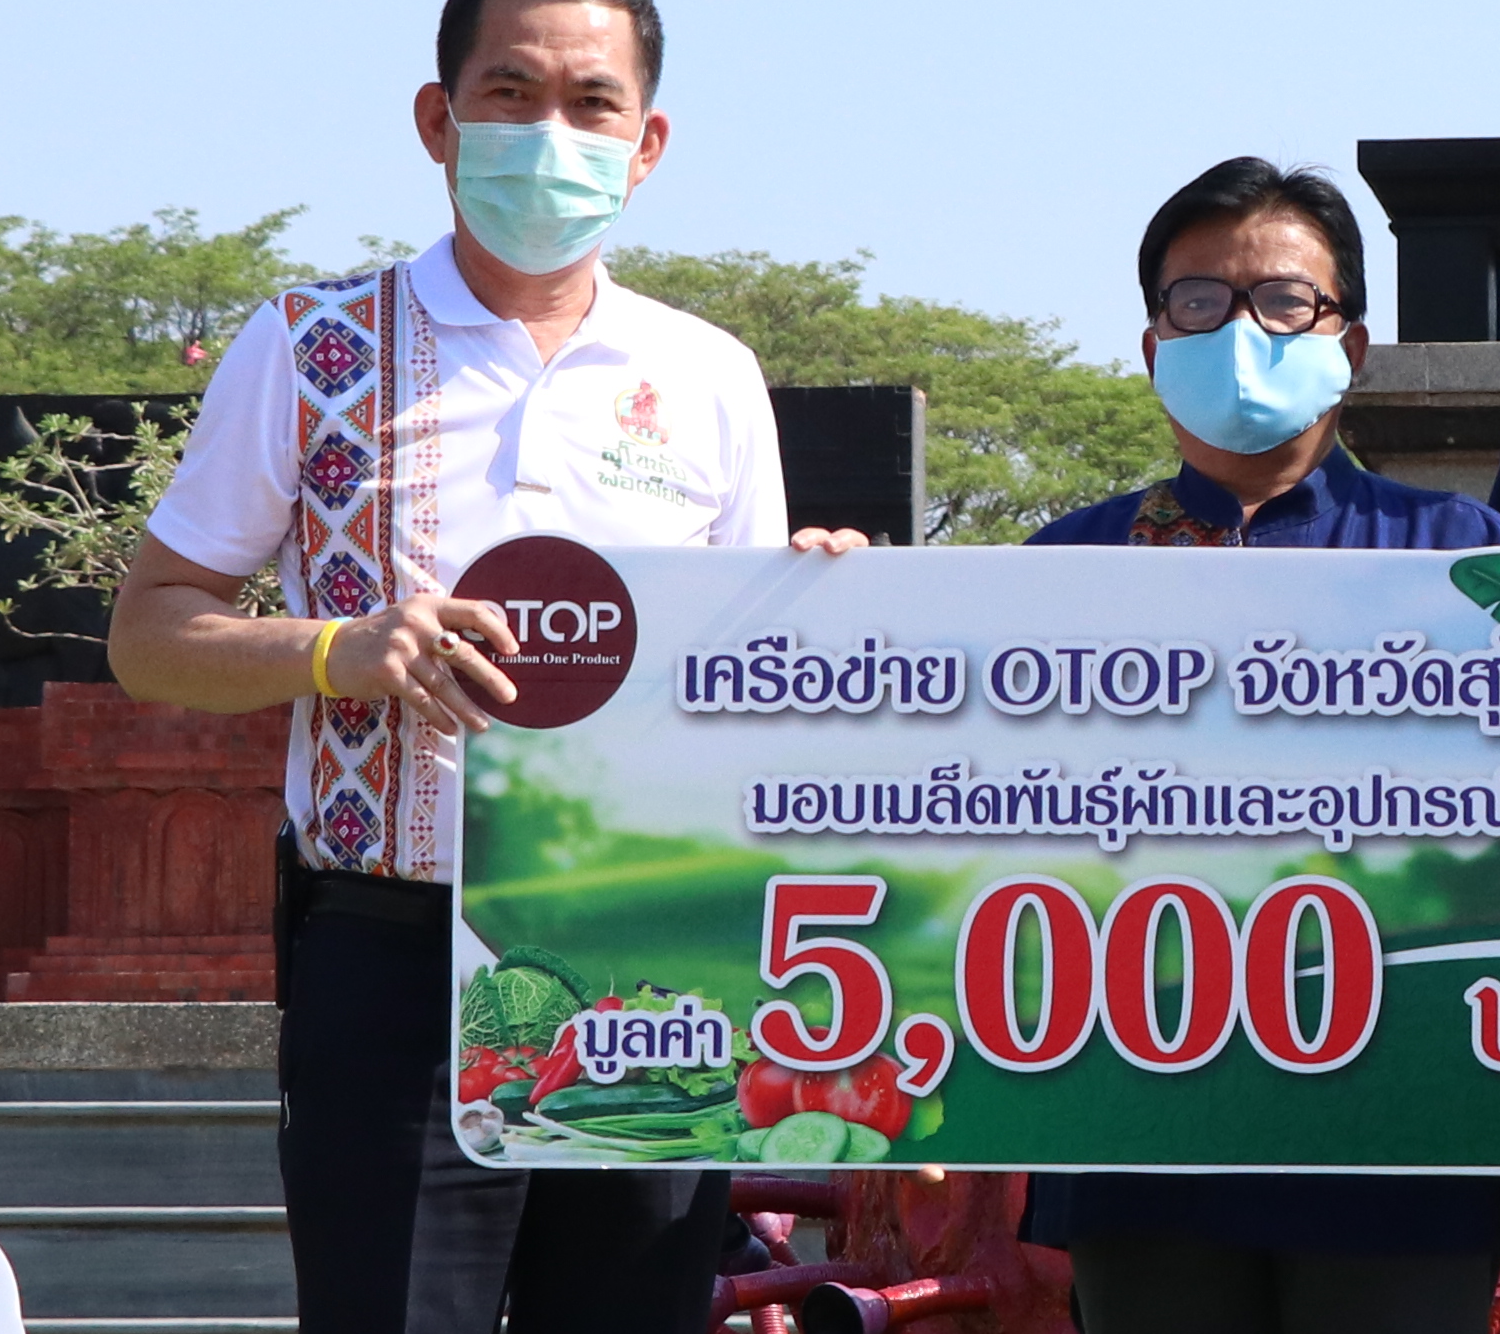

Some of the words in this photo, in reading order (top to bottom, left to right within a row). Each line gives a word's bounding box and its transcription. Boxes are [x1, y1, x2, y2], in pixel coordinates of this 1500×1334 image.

[543, 652, 569, 665] One
[572, 653, 620, 666] Product
[684, 636, 960, 707] เครือข่าย
[991, 647, 1206, 708] OTOP
[583, 1003, 725, 1074] มูลค่า
[754, 881, 1376, 1092] 5,000
